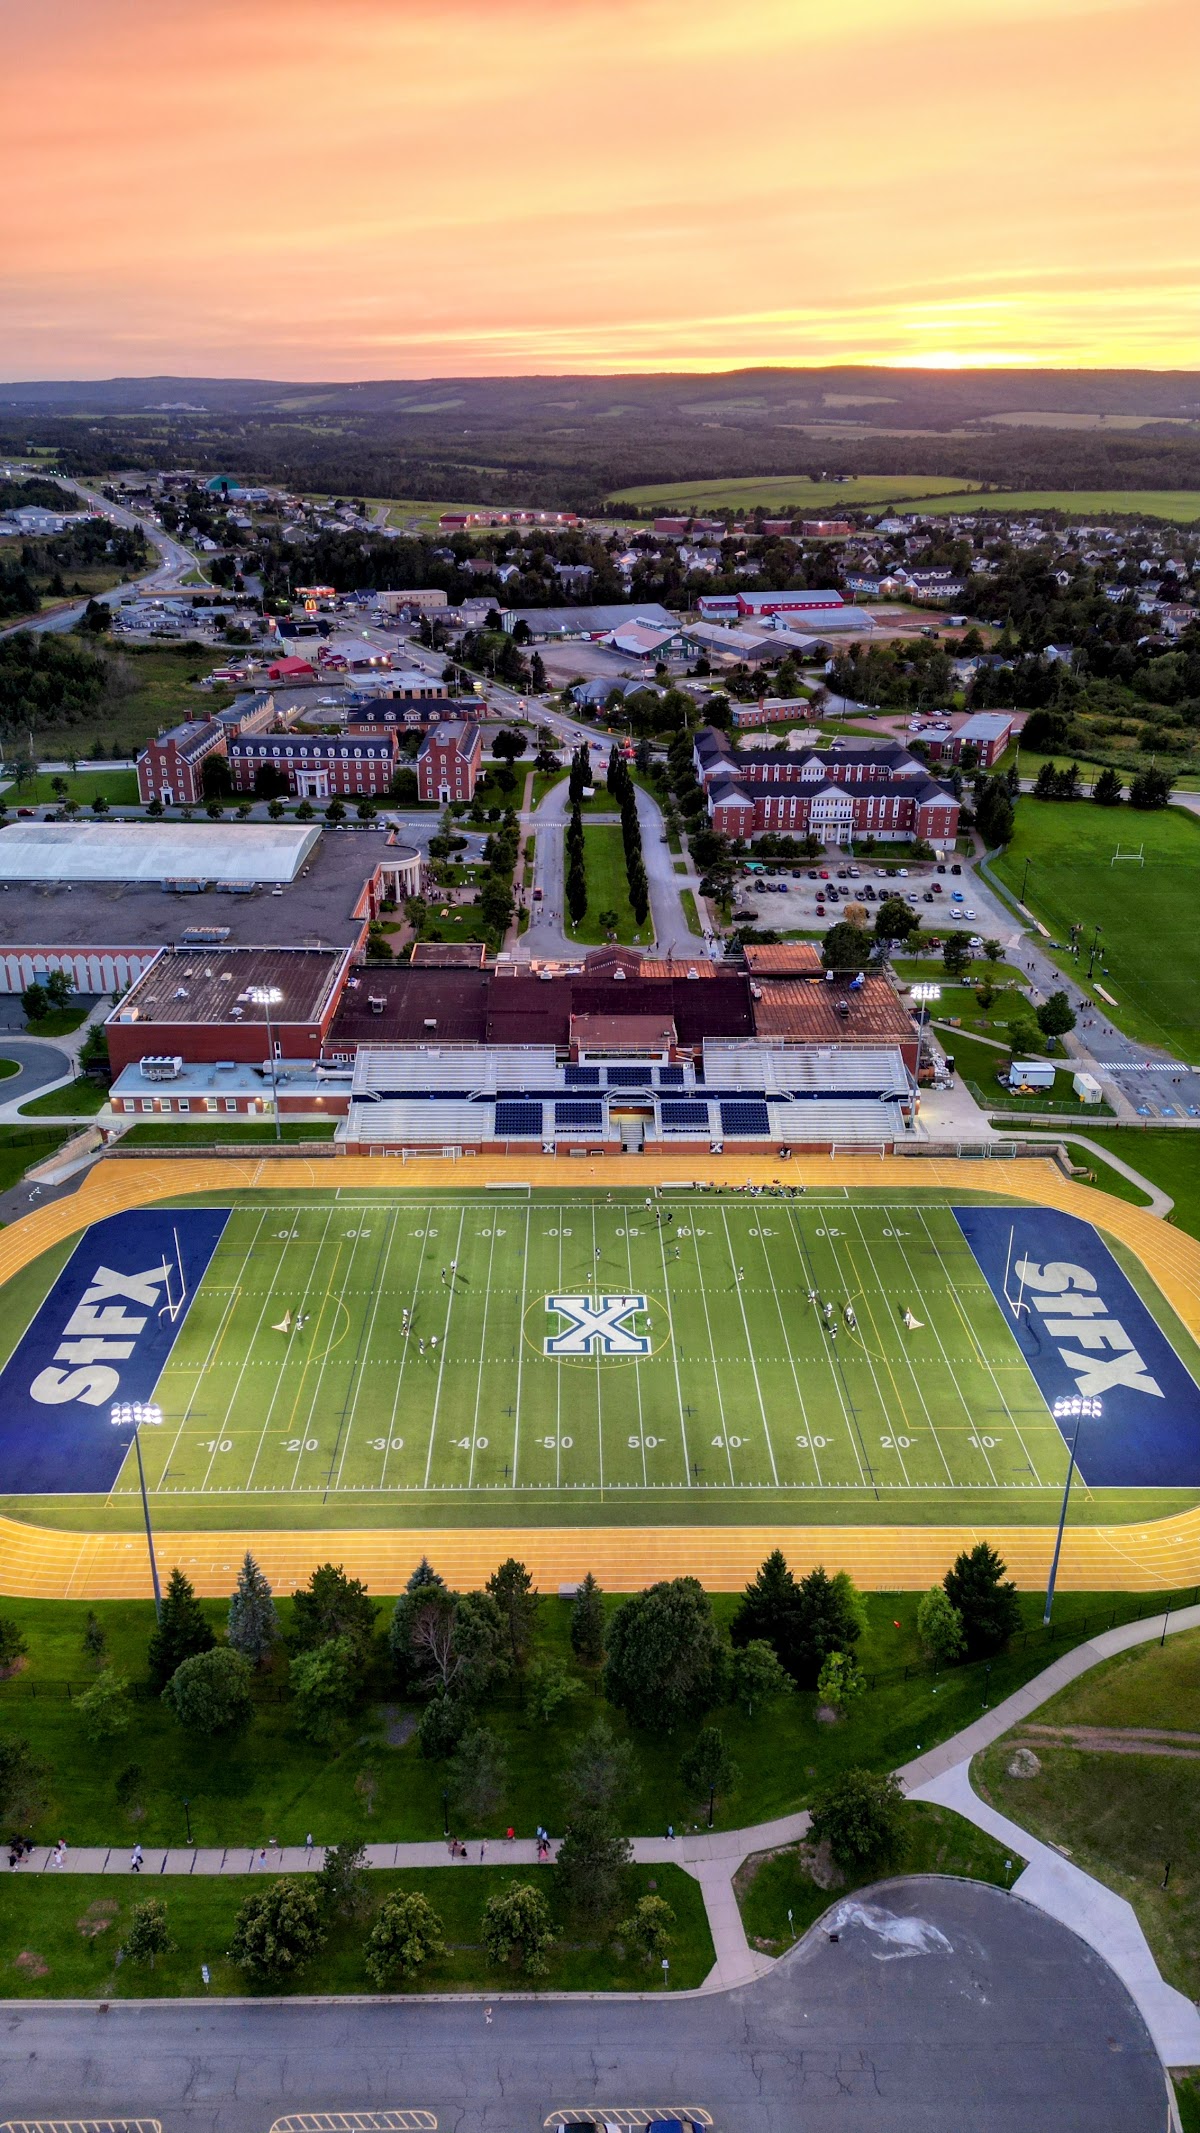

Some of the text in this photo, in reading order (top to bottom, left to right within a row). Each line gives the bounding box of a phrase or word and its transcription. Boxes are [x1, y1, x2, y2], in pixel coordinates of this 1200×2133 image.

[278, 1230, 299, 1238] 10
[346, 1229, 372, 1238] 20
[414, 1229, 438, 1237] 30
[481, 1228, 506, 1237] 40
[549, 1228, 572, 1237] 50
[615, 1228, 639, 1237] 50
[748, 1228, 773, 1237] 30
[815, 1228, 841, 1237] 20
[882, 1228, 907, 1237] 10
[544, 1295, 652, 1355] X
[1014, 1260, 1165, 1398] StFX
[30, 1264, 173, 1406] StFX
[206, 1440, 232, 1452] 10
[286, 1438, 318, 1451] 20
[373, 1438, 403, 1450] 30
[457, 1437, 488, 1449] 40
[543, 1436, 573, 1448] 50
[627, 1436, 657, 1448] 50
[711, 1436, 741, 1448] 40
[795, 1436, 826, 1448] 30
[879, 1436, 910, 1448] 20
[967, 1436, 995, 1448] 10
